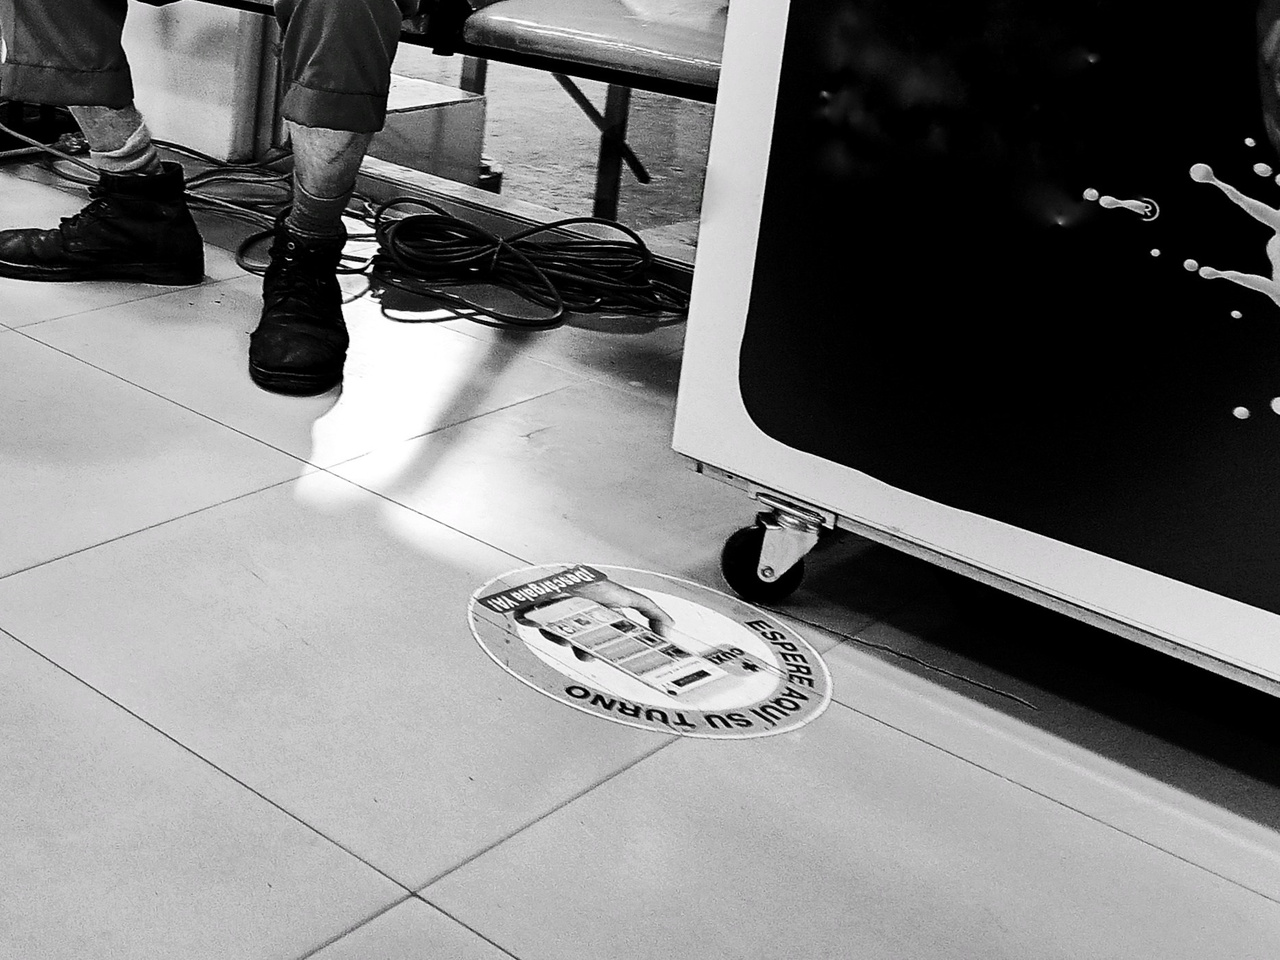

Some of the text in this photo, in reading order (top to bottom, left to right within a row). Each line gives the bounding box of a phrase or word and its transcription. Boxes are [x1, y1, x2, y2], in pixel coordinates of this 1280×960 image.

[743, 619, 815, 689] ESPERE
[564, 685, 697, 731] TURNO
[703, 712, 754, 730] SU
[748, 685, 810, 731] AQUÍ
